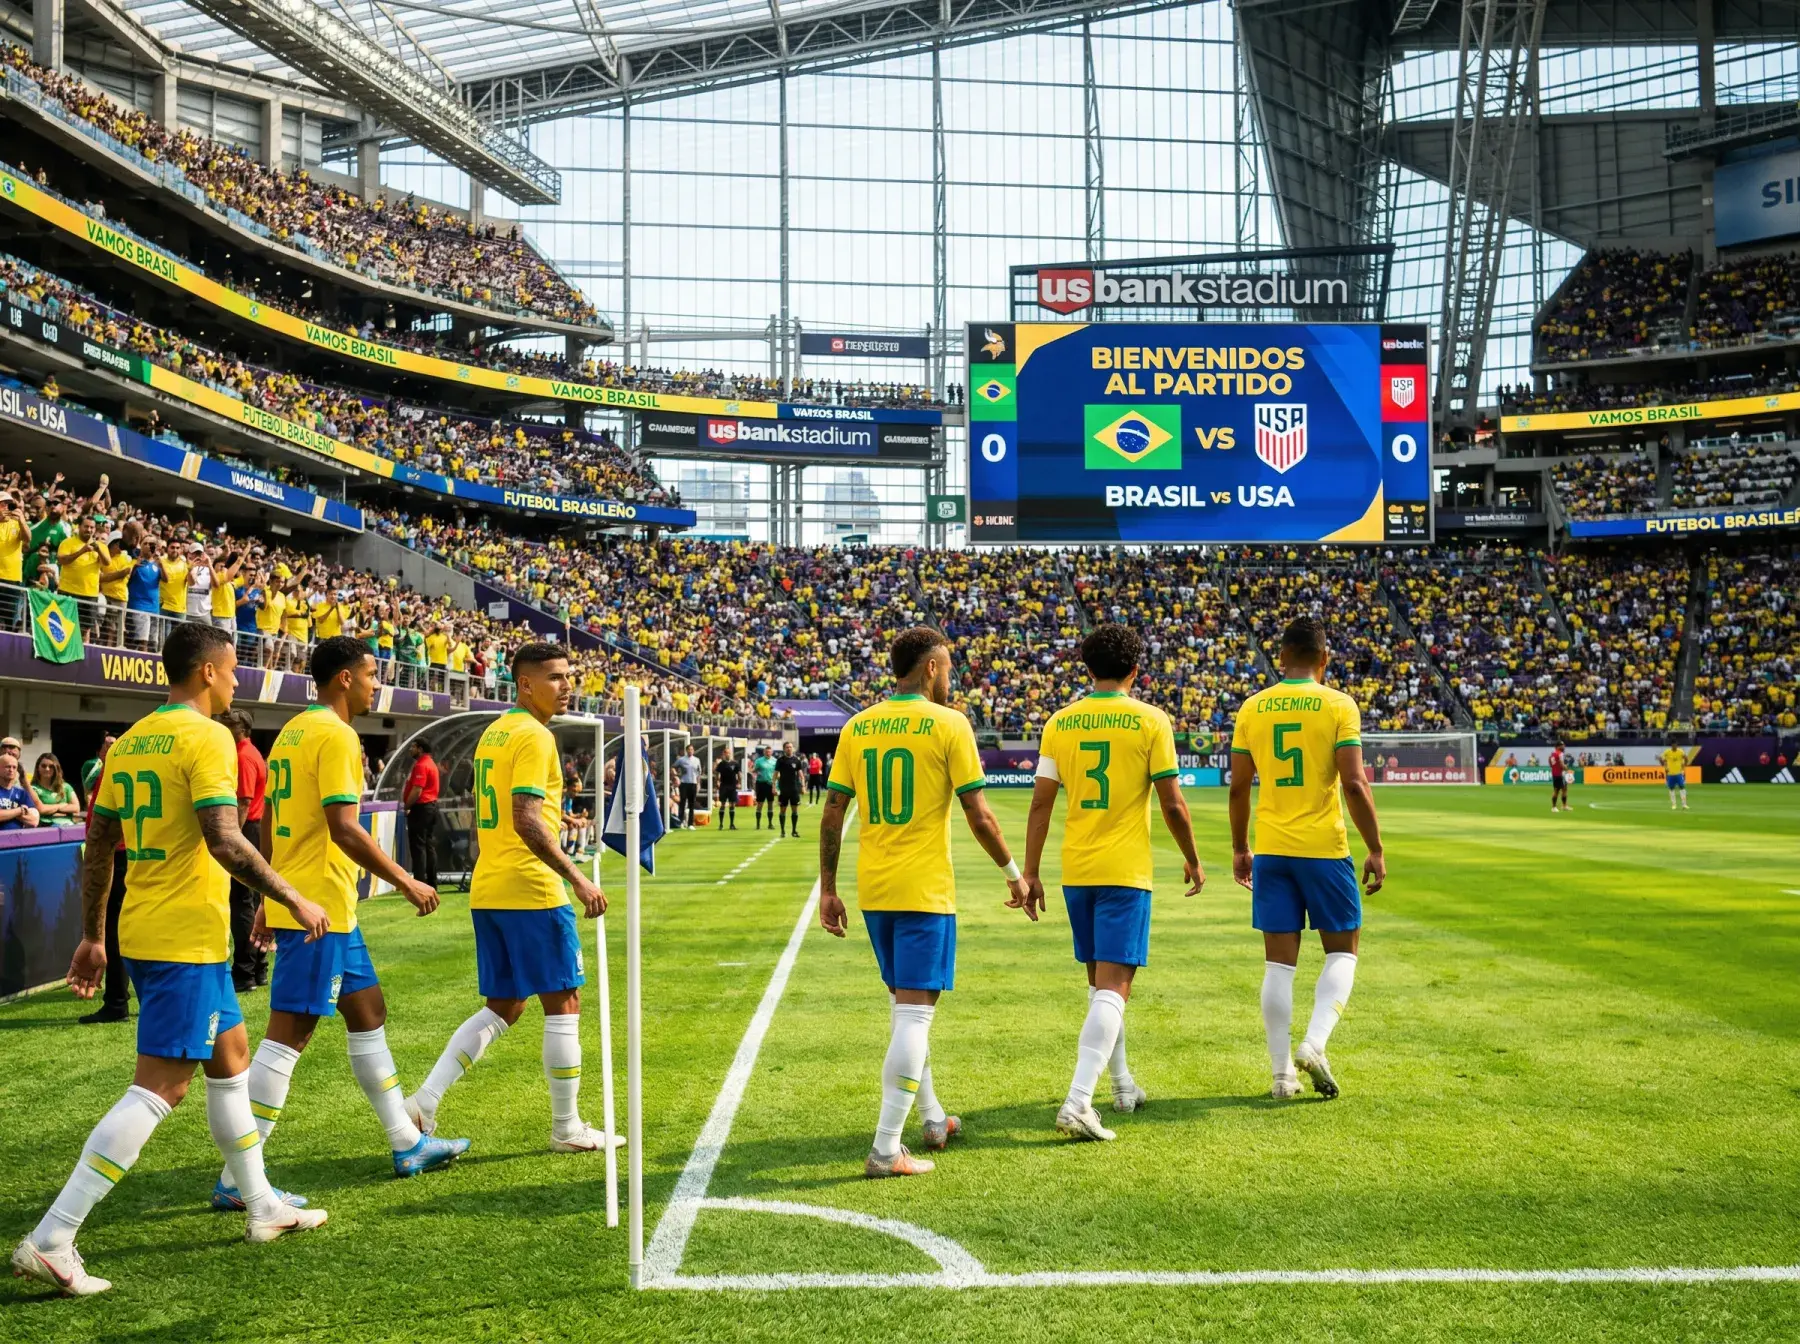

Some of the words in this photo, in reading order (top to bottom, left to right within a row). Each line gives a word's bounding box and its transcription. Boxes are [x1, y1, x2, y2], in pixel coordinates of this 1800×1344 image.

[1761, 177, 1800, 208] SI
[86, 220, 134, 260] VAMOS
[136, 248, 179, 282] BRASIL
[305, 324, 348, 351] VAMOS
[351, 340, 397, 365] BRASIL
[1091, 346, 1305, 370] BIENVENIDOS
[551, 382, 603, 401] VAMOS
[607, 390, 661, 408] BRASIL
[1104, 372, 1146, 395] AL
[1154, 372, 1293, 396] PARTIDO
[0, 387, 24, 418] SIL
[40, 402, 67, 434] USA
[243, 406, 286, 436] FUTEBOL
[834, 409, 874, 421] BRASIL
[1258, 407, 1304, 434] USA
[1588, 410, 1643, 425] VAMOS
[1647, 405, 1703, 421] BRASIL
[981, 433, 1007, 463] 0
[1195, 427, 1236, 450] VS
[1391, 434, 1417, 463] 0
[231, 470, 254, 491] VAMOS
[504, 490, 560, 511] FUTEBOL
[1105, 485, 1206, 507] BRASIL
[1237, 485, 1295, 507] USA
[1646, 516, 1721, 533] FUTEBOL
[101, 653, 154, 685] VAMOS
[1257, 696, 1322, 714] CASEMIRO
[853, 717, 909, 737] NEYMAR
[912, 717, 934, 736] JR
[1056, 713, 1142, 732] MARQUINHOS
[1273, 722, 1304, 787] 5
[863, 747, 914, 824] 10
[984, 773, 1037, 784] IENVENIDO
[1079, 741, 1110, 809] 3
[1602, 768, 1665, 783] Continenta
[475, 758, 499, 829] 15
